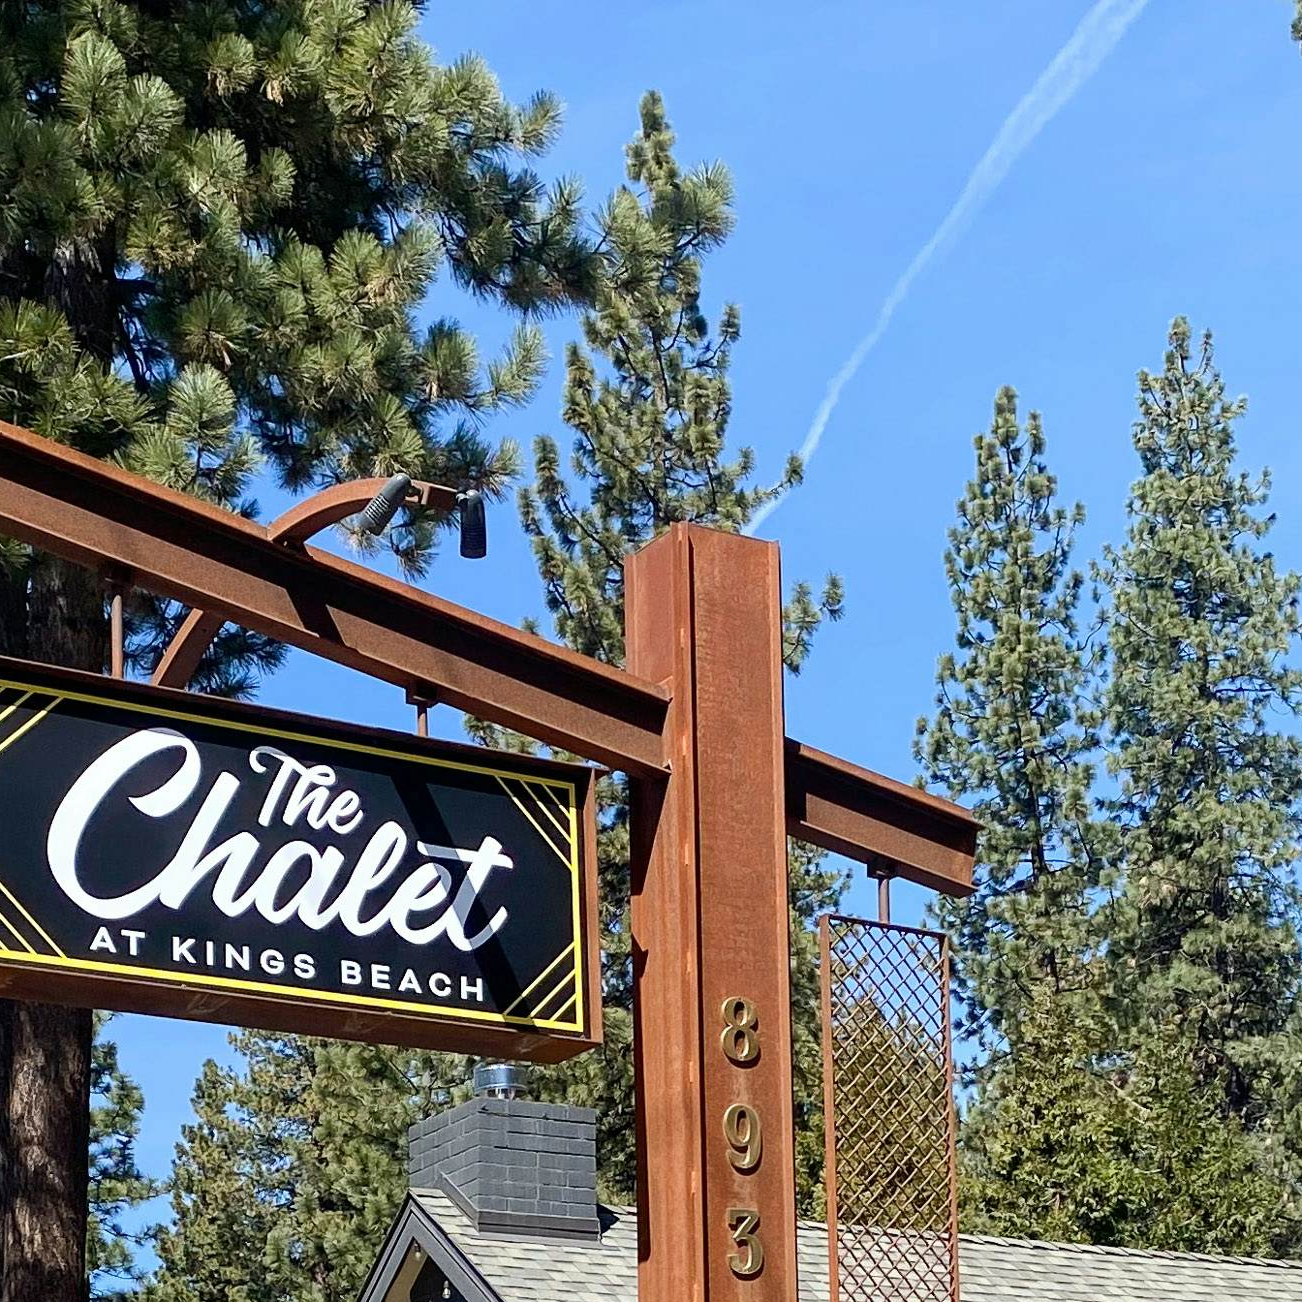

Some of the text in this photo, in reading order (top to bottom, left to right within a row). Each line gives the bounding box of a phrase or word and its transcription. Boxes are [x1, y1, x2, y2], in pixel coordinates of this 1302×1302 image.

[249, 746, 365, 832] The
[47, 728, 514, 952] Chalet
[90, 927, 485, 1002] AT KINGS BEACH
